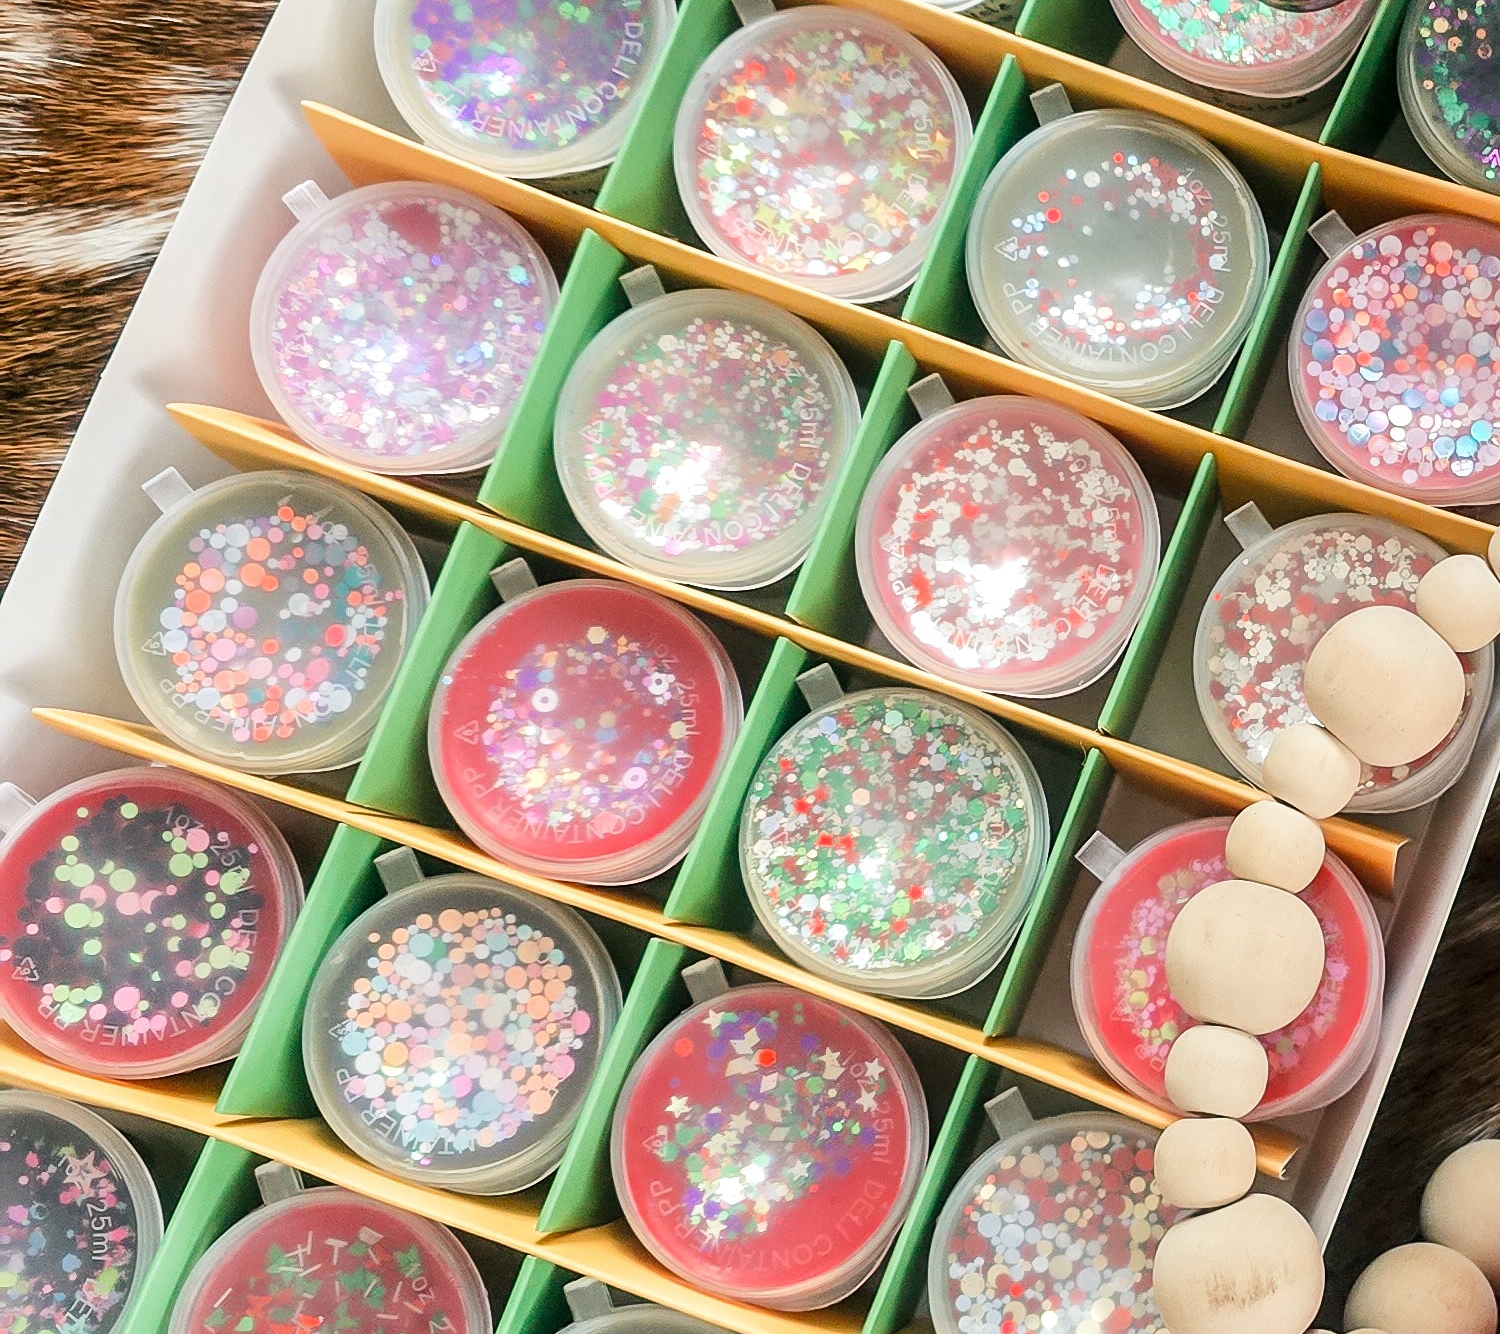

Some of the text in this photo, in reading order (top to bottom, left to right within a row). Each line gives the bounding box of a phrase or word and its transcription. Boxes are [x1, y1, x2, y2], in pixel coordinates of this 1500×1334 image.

[613, 20, 645, 80] DELI
[1003, 280, 1034, 316] PP
[1029, 320, 1178, 364] CONTAINER
[160, 678, 194, 710] PP
[463, 766, 500, 800] PP
[336, 1067, 368, 1104] PP
[649, 1179, 682, 1218] PP
[85, 1201, 114, 1261] 25ml
